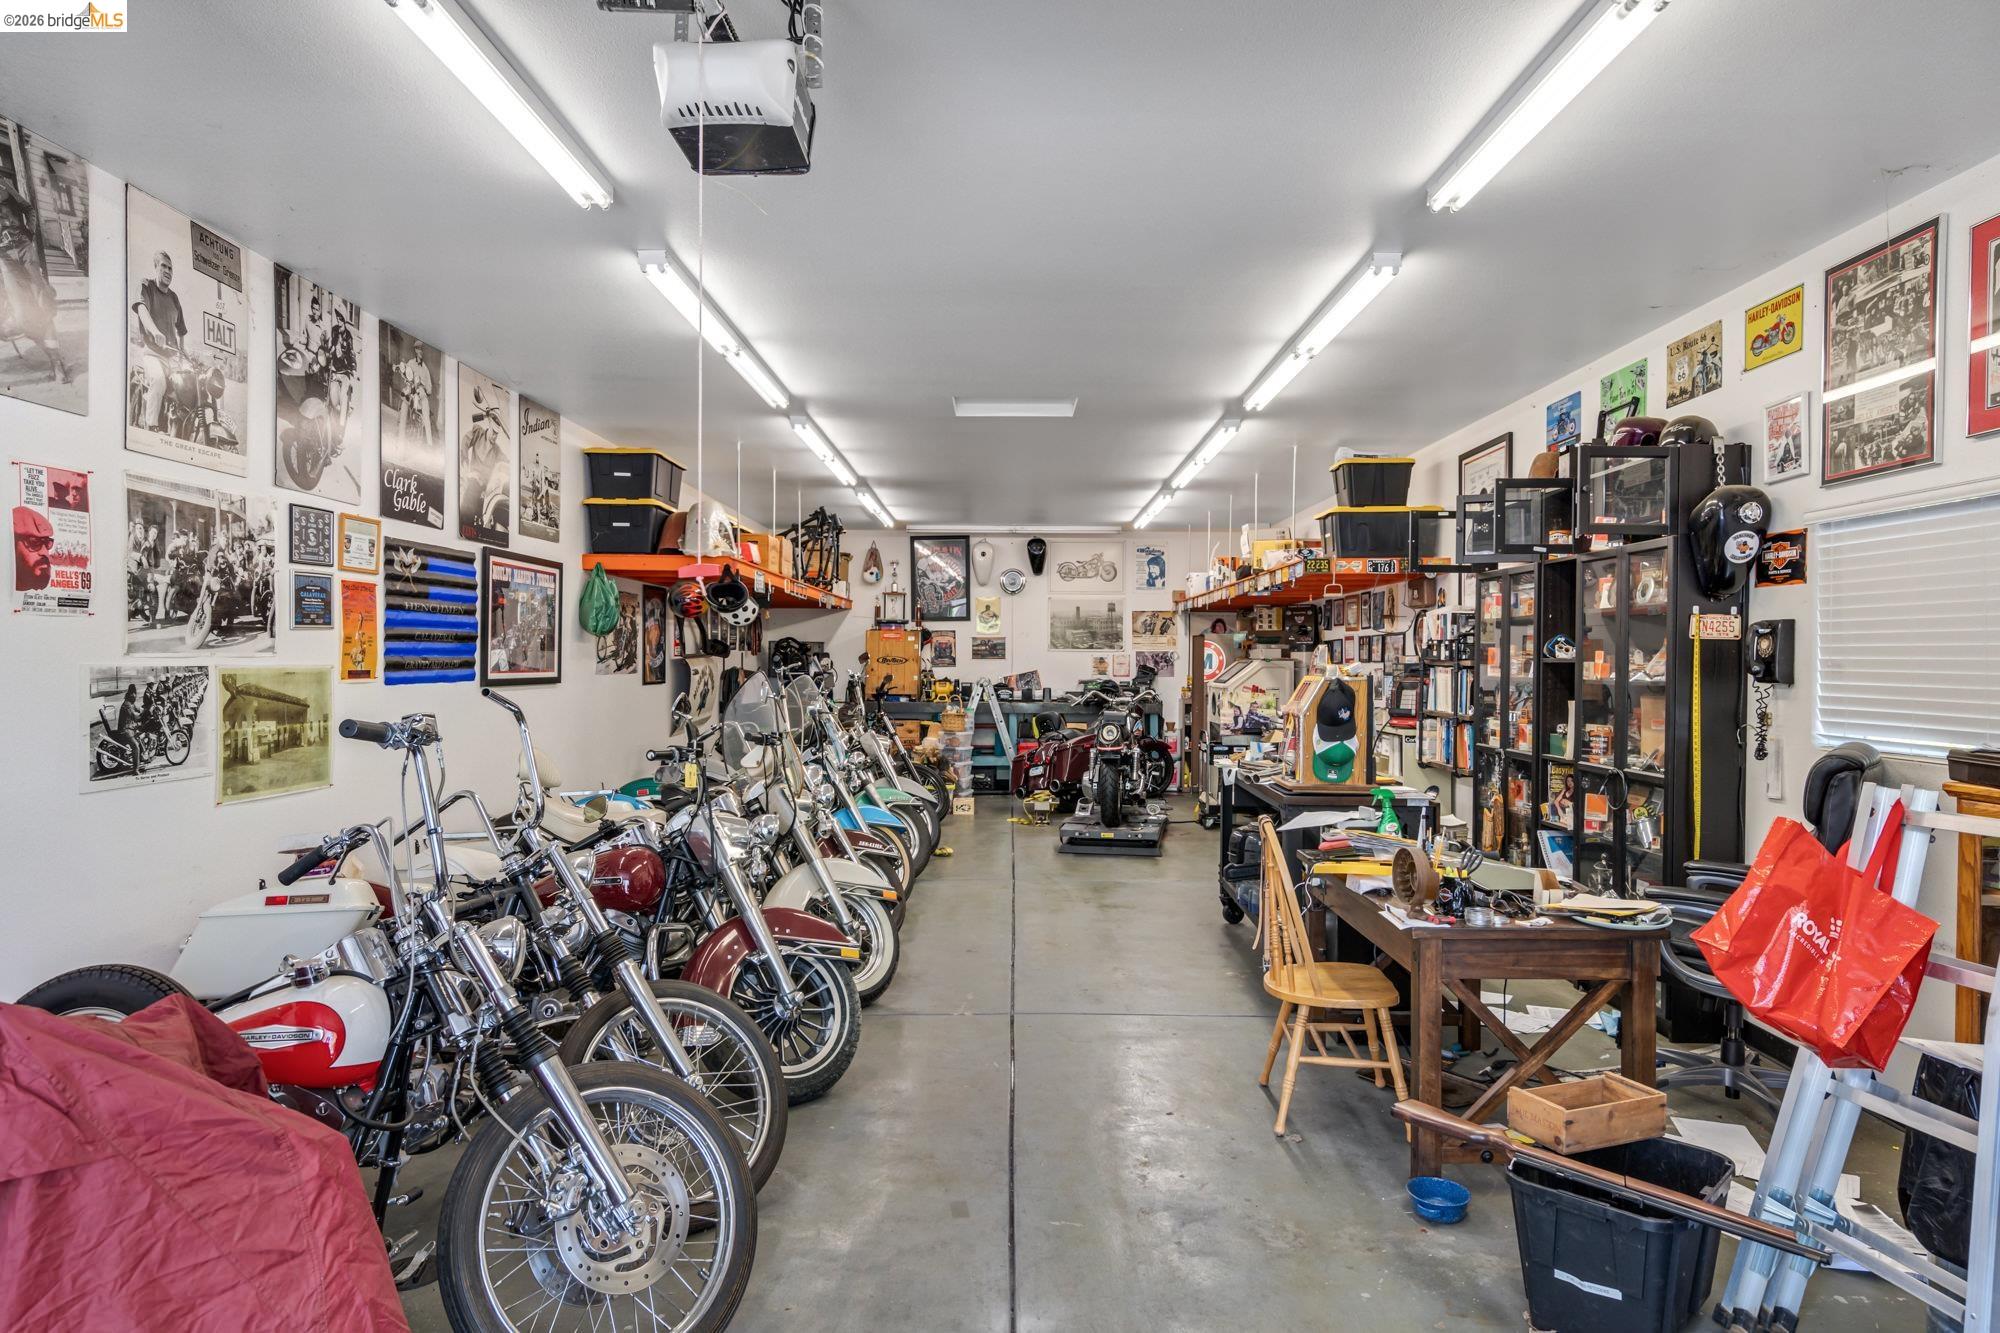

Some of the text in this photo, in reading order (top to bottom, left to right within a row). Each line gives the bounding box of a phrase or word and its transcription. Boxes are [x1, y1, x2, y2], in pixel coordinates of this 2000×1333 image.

[199, 231, 234, 260] ACHTUNG
[1747, 290, 1801, 325] HARLEY-DAVIDSON
[206, 318, 234, 349] HALT
[1682, 337, 1699, 351] Route
[1677, 371, 1687, 381] 66
[522, 407, 550, 436] Indian
[159, 438, 221, 460] THE GREAT ESCAPE
[384, 468, 418, 495] Clark
[393, 489, 427, 514] Gable
[50, 579, 80, 589] ANGELS
[55, 570, 79, 580] HELL'S
[404, 601, 465, 615] HENCHMEN
[1791, 912, 1830, 955] ROYAL
